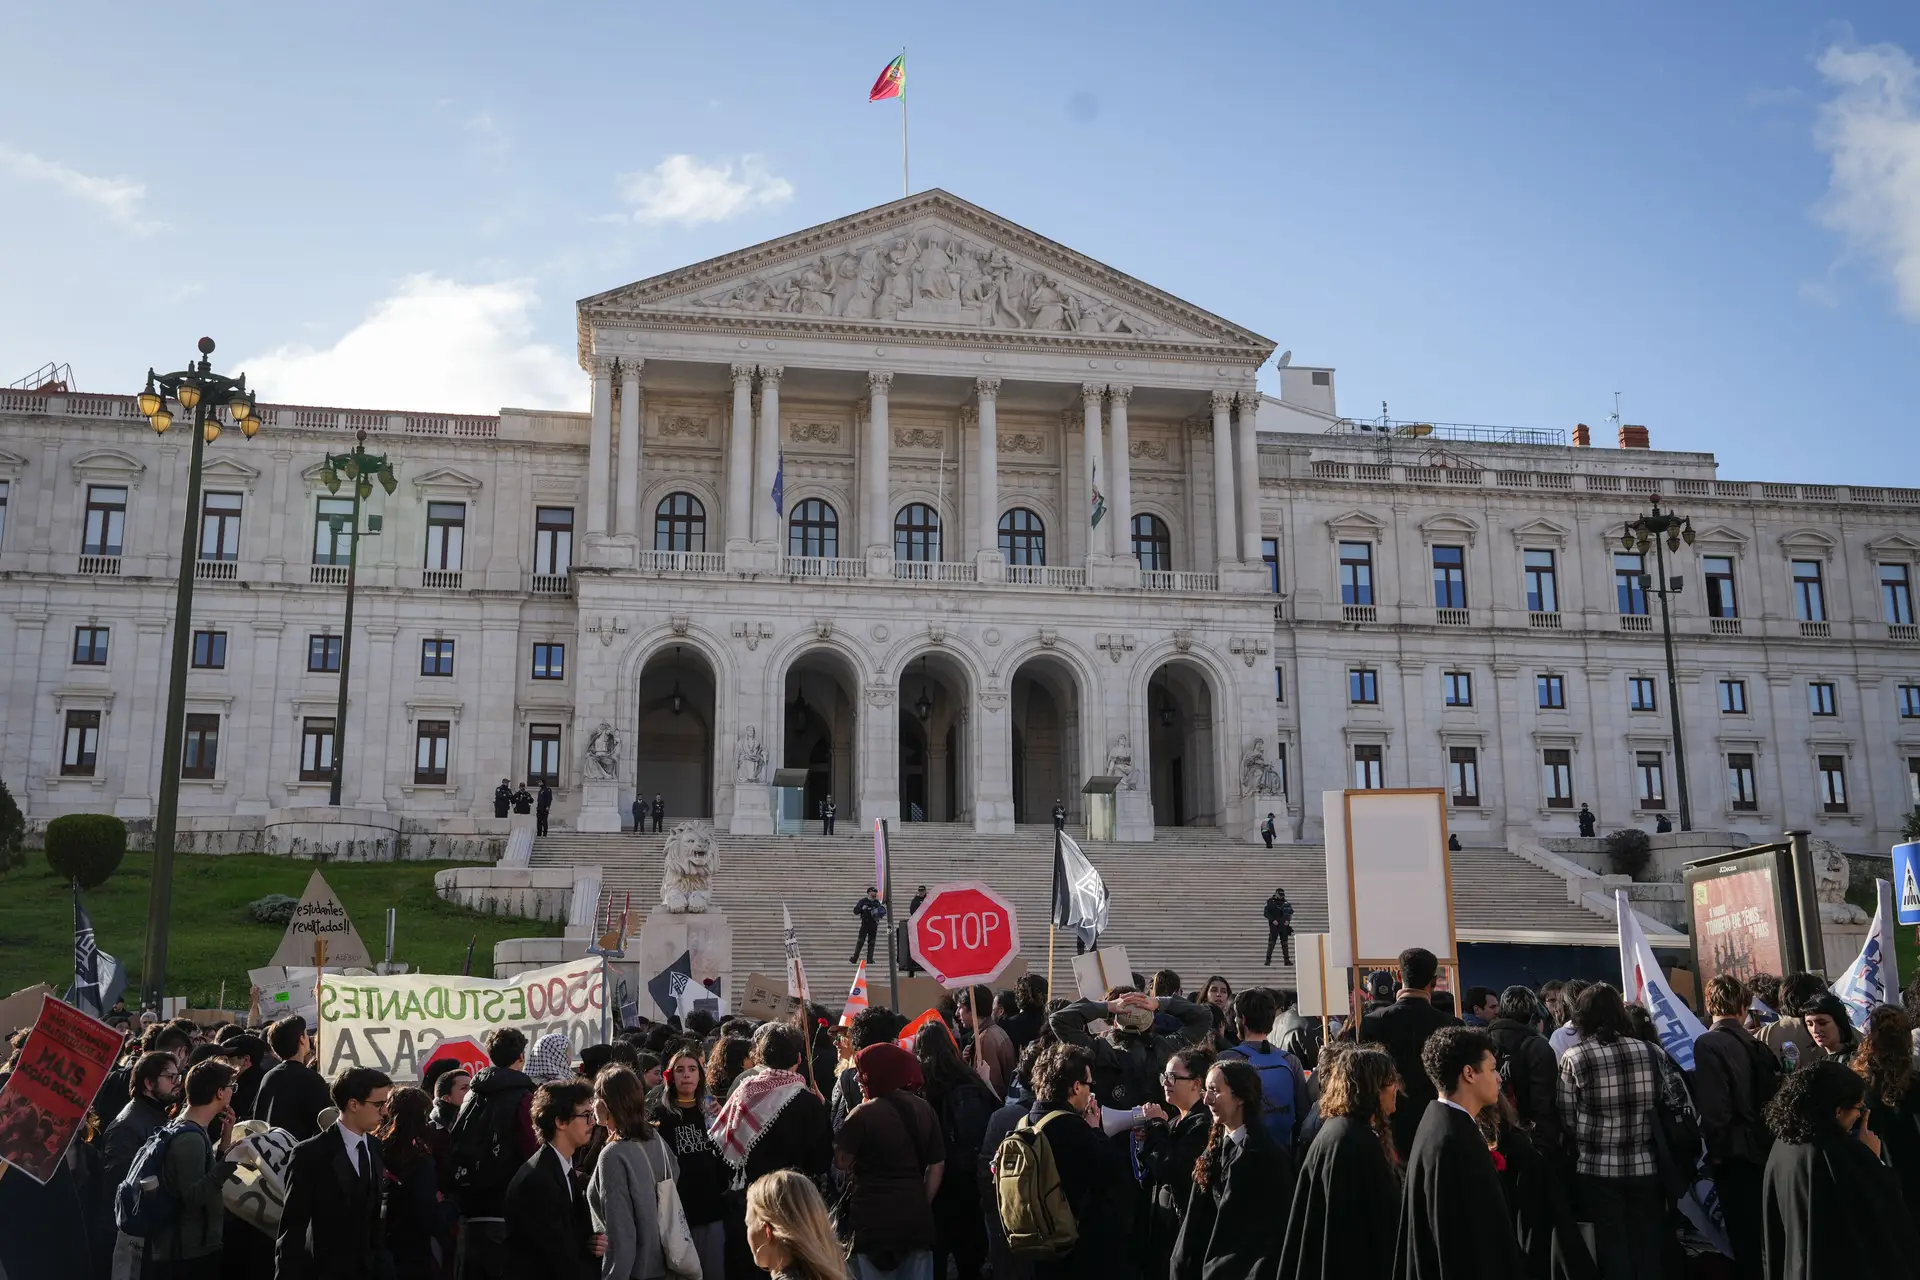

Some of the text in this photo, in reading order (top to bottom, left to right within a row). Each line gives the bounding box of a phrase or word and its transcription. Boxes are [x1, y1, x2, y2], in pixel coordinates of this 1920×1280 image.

[297, 899, 344, 916] estudantes
[926, 912, 999, 951] STOP
[36, 1045, 86, 1087] MAIS
